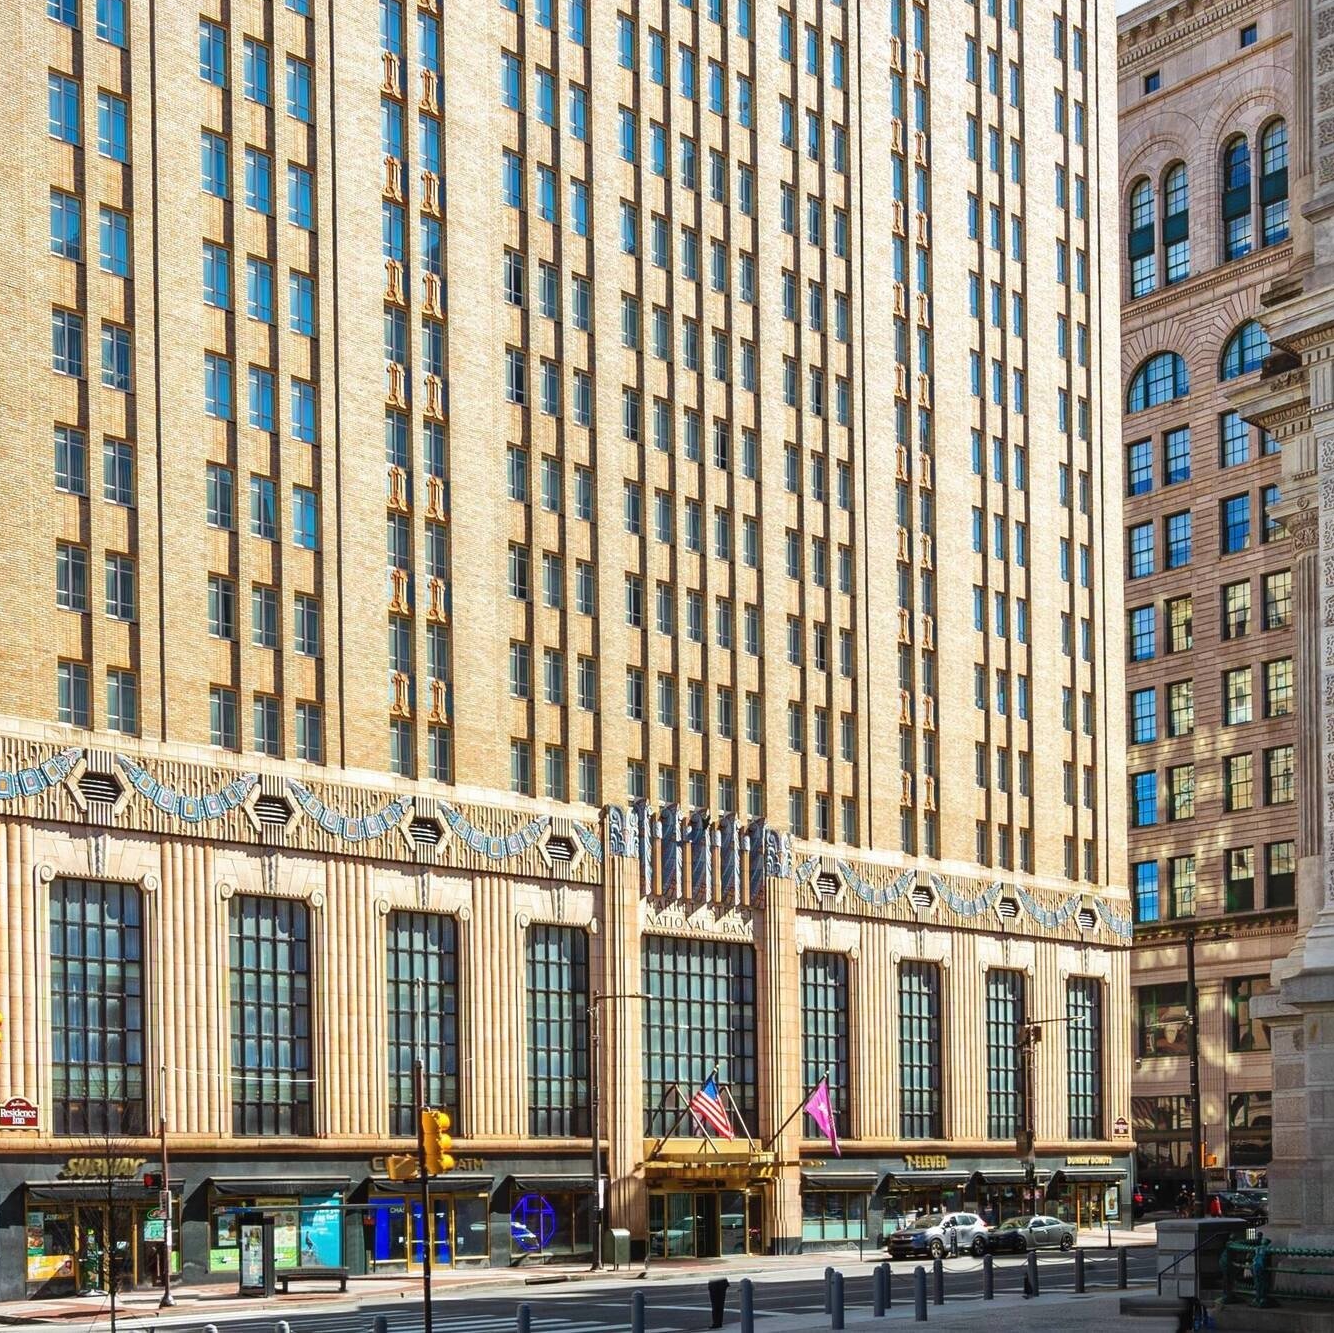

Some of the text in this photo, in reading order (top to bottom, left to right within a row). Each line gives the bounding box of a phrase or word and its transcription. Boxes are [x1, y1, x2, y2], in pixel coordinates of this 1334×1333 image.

[646, 913, 755, 936] NATIONAL BANK
[0, 1108, 36, 1118] Residence
[12, 1116, 26, 1125] Inn
[63, 1157, 147, 1177] SUBWAY
[456, 1158, 484, 1171] ATM
[905, 1154, 947, 1169] 7-ELEVEN
